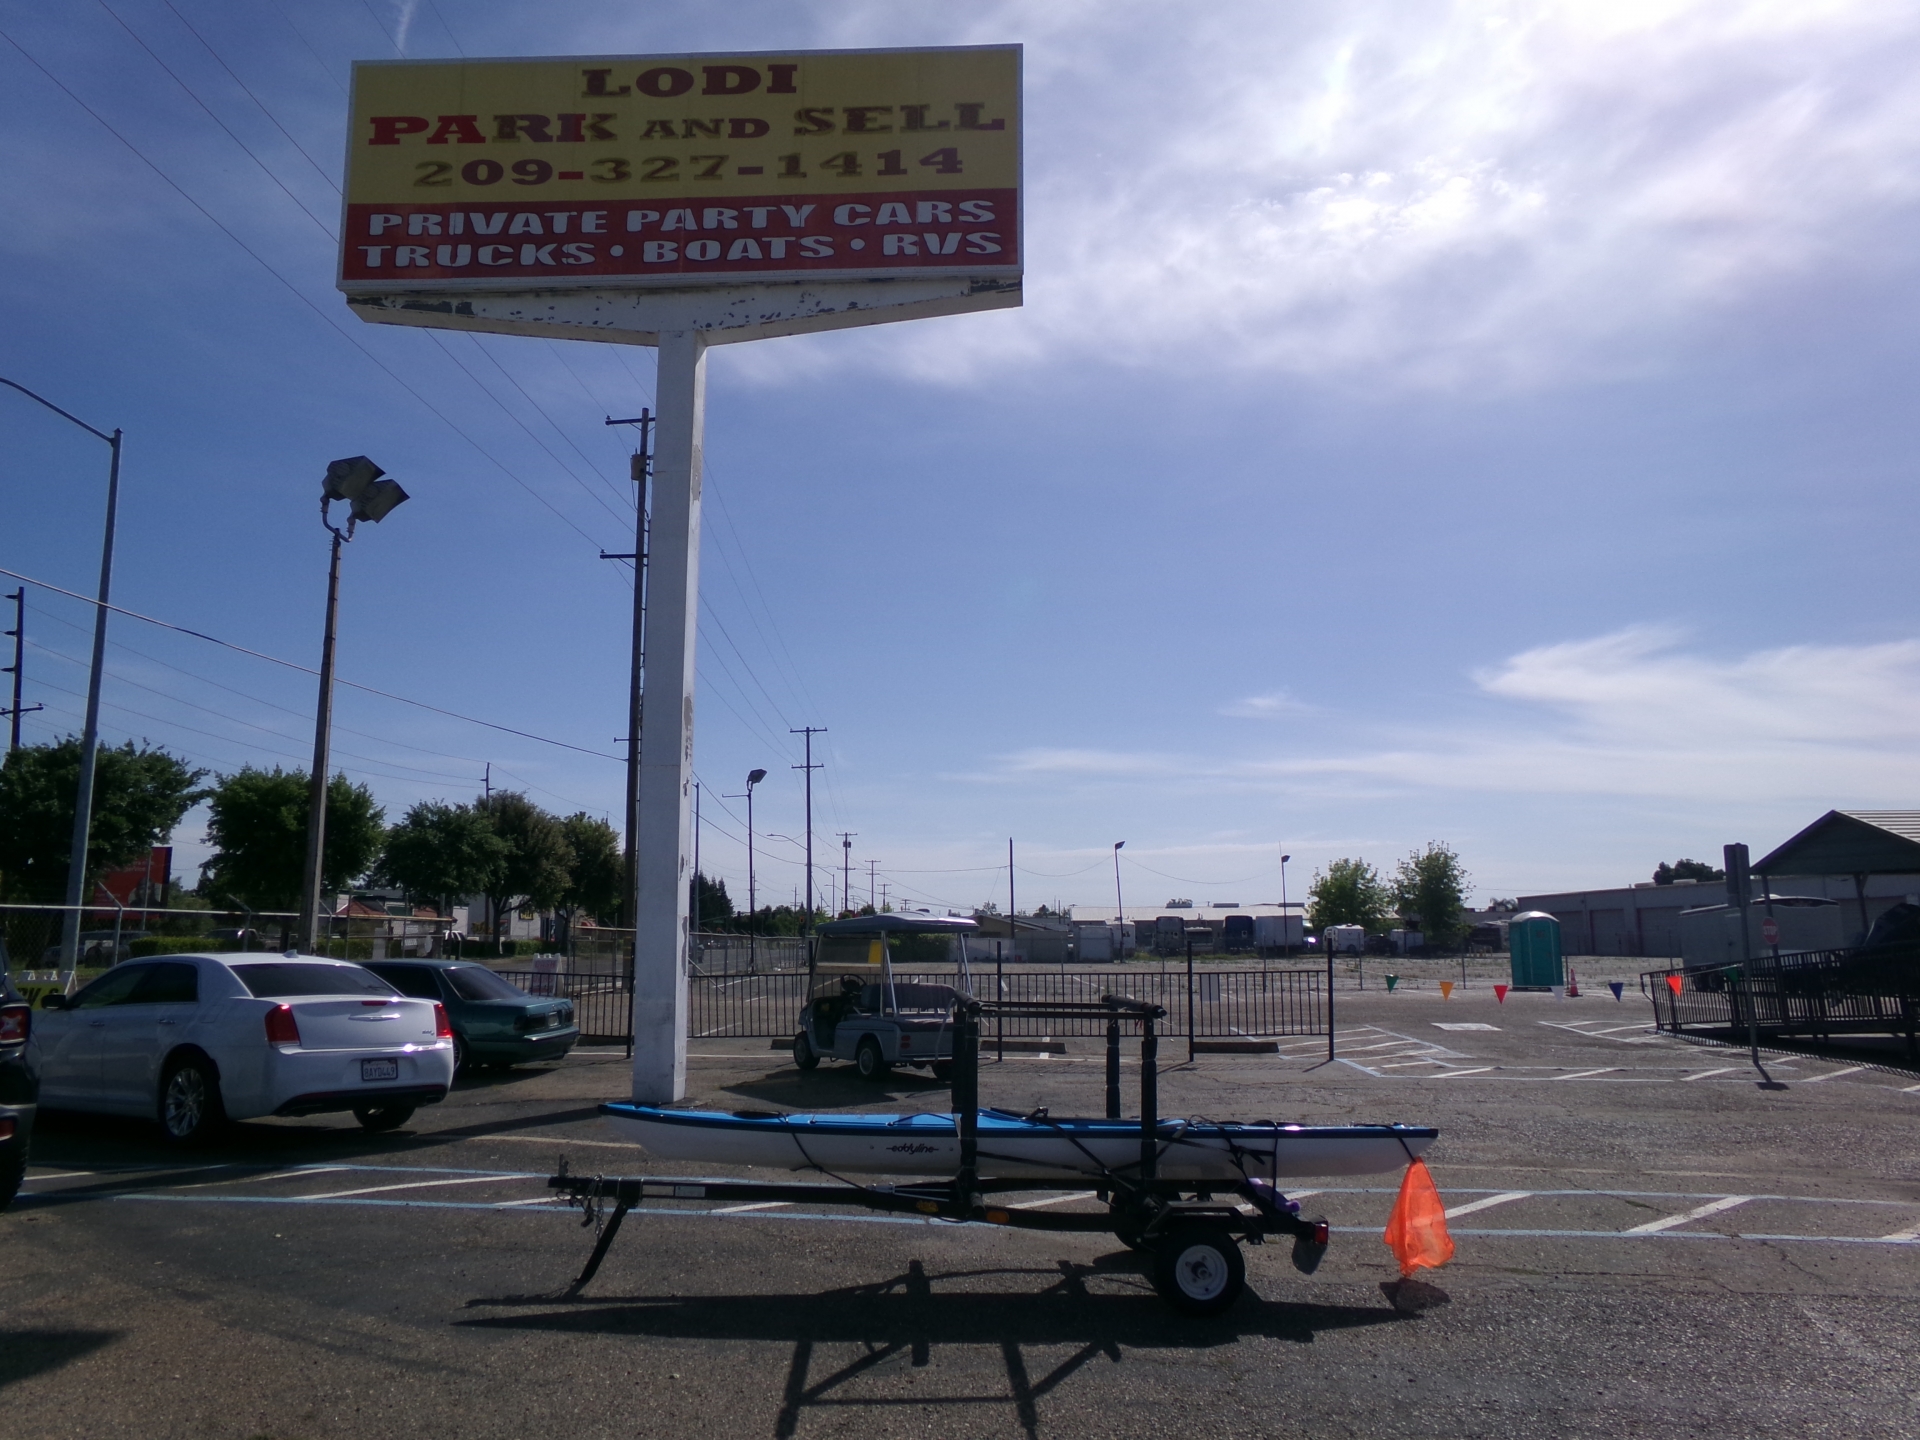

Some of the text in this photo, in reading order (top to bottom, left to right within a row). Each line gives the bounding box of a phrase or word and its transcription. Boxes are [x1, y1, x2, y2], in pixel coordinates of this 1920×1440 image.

[581, 64, 797, 98] LODI
[368, 102, 1005, 145] PARK AND SELL
[413, 148, 963, 187] 209-327-1414
[369, 200, 996, 236] PRIVATE PARTY CARS
[357, 232, 1002, 267] TRUCKS BOATS RVS
[1762, 925, 1778, 936] STOP
[889, 1143, 937, 1155] eddyline
